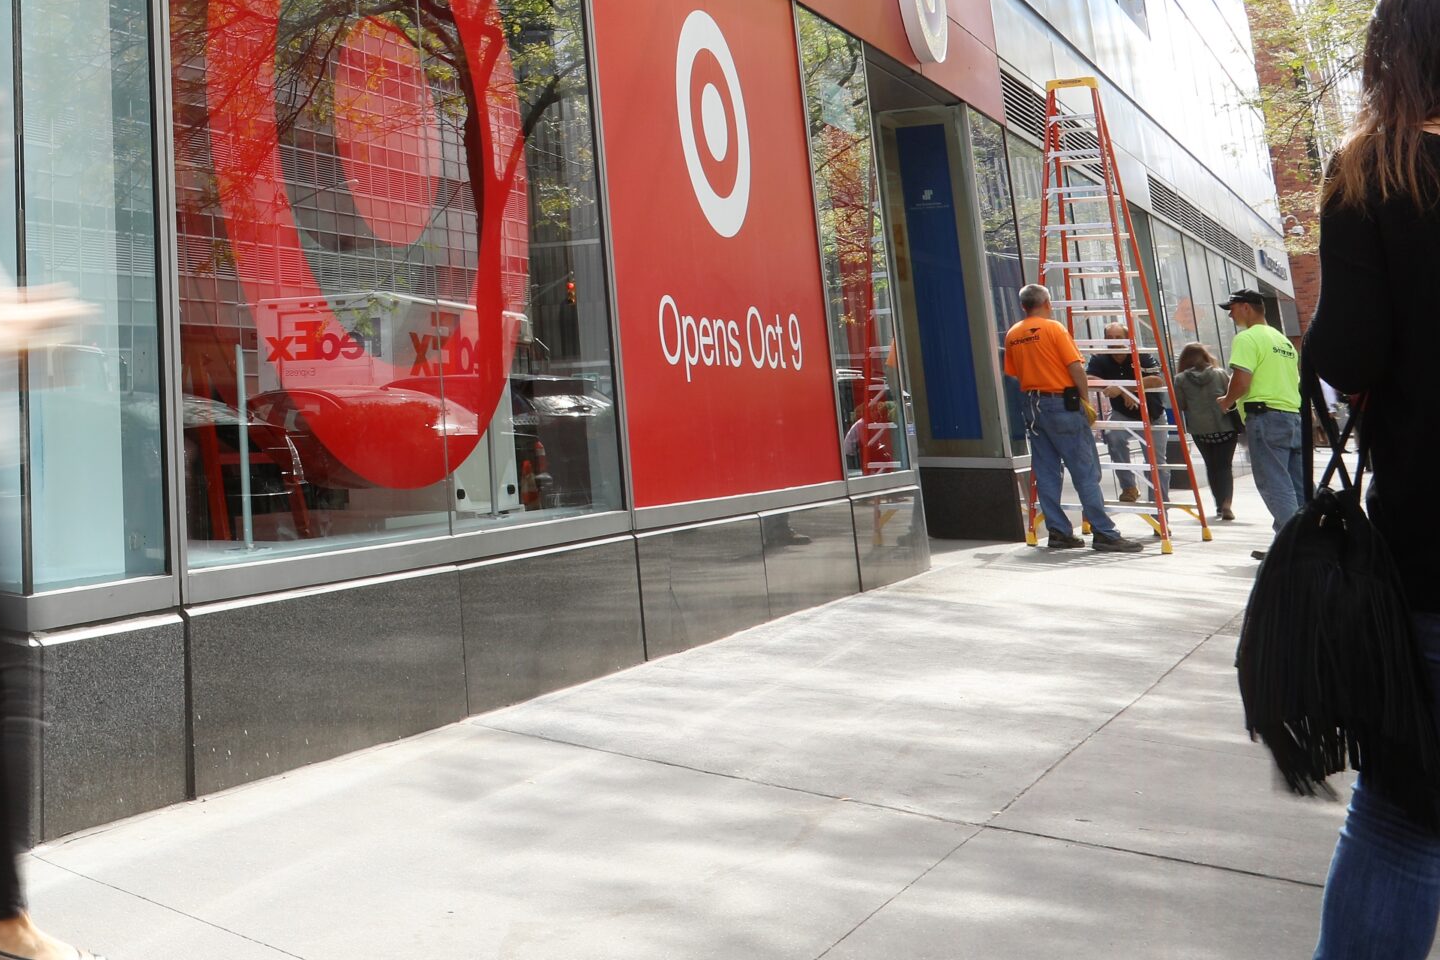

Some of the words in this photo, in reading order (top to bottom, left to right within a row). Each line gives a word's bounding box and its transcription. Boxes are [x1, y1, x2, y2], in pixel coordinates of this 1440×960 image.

[658, 294, 743, 383] Opens
[746, 305, 787, 370] Oct
[788, 313, 803, 372] 9
